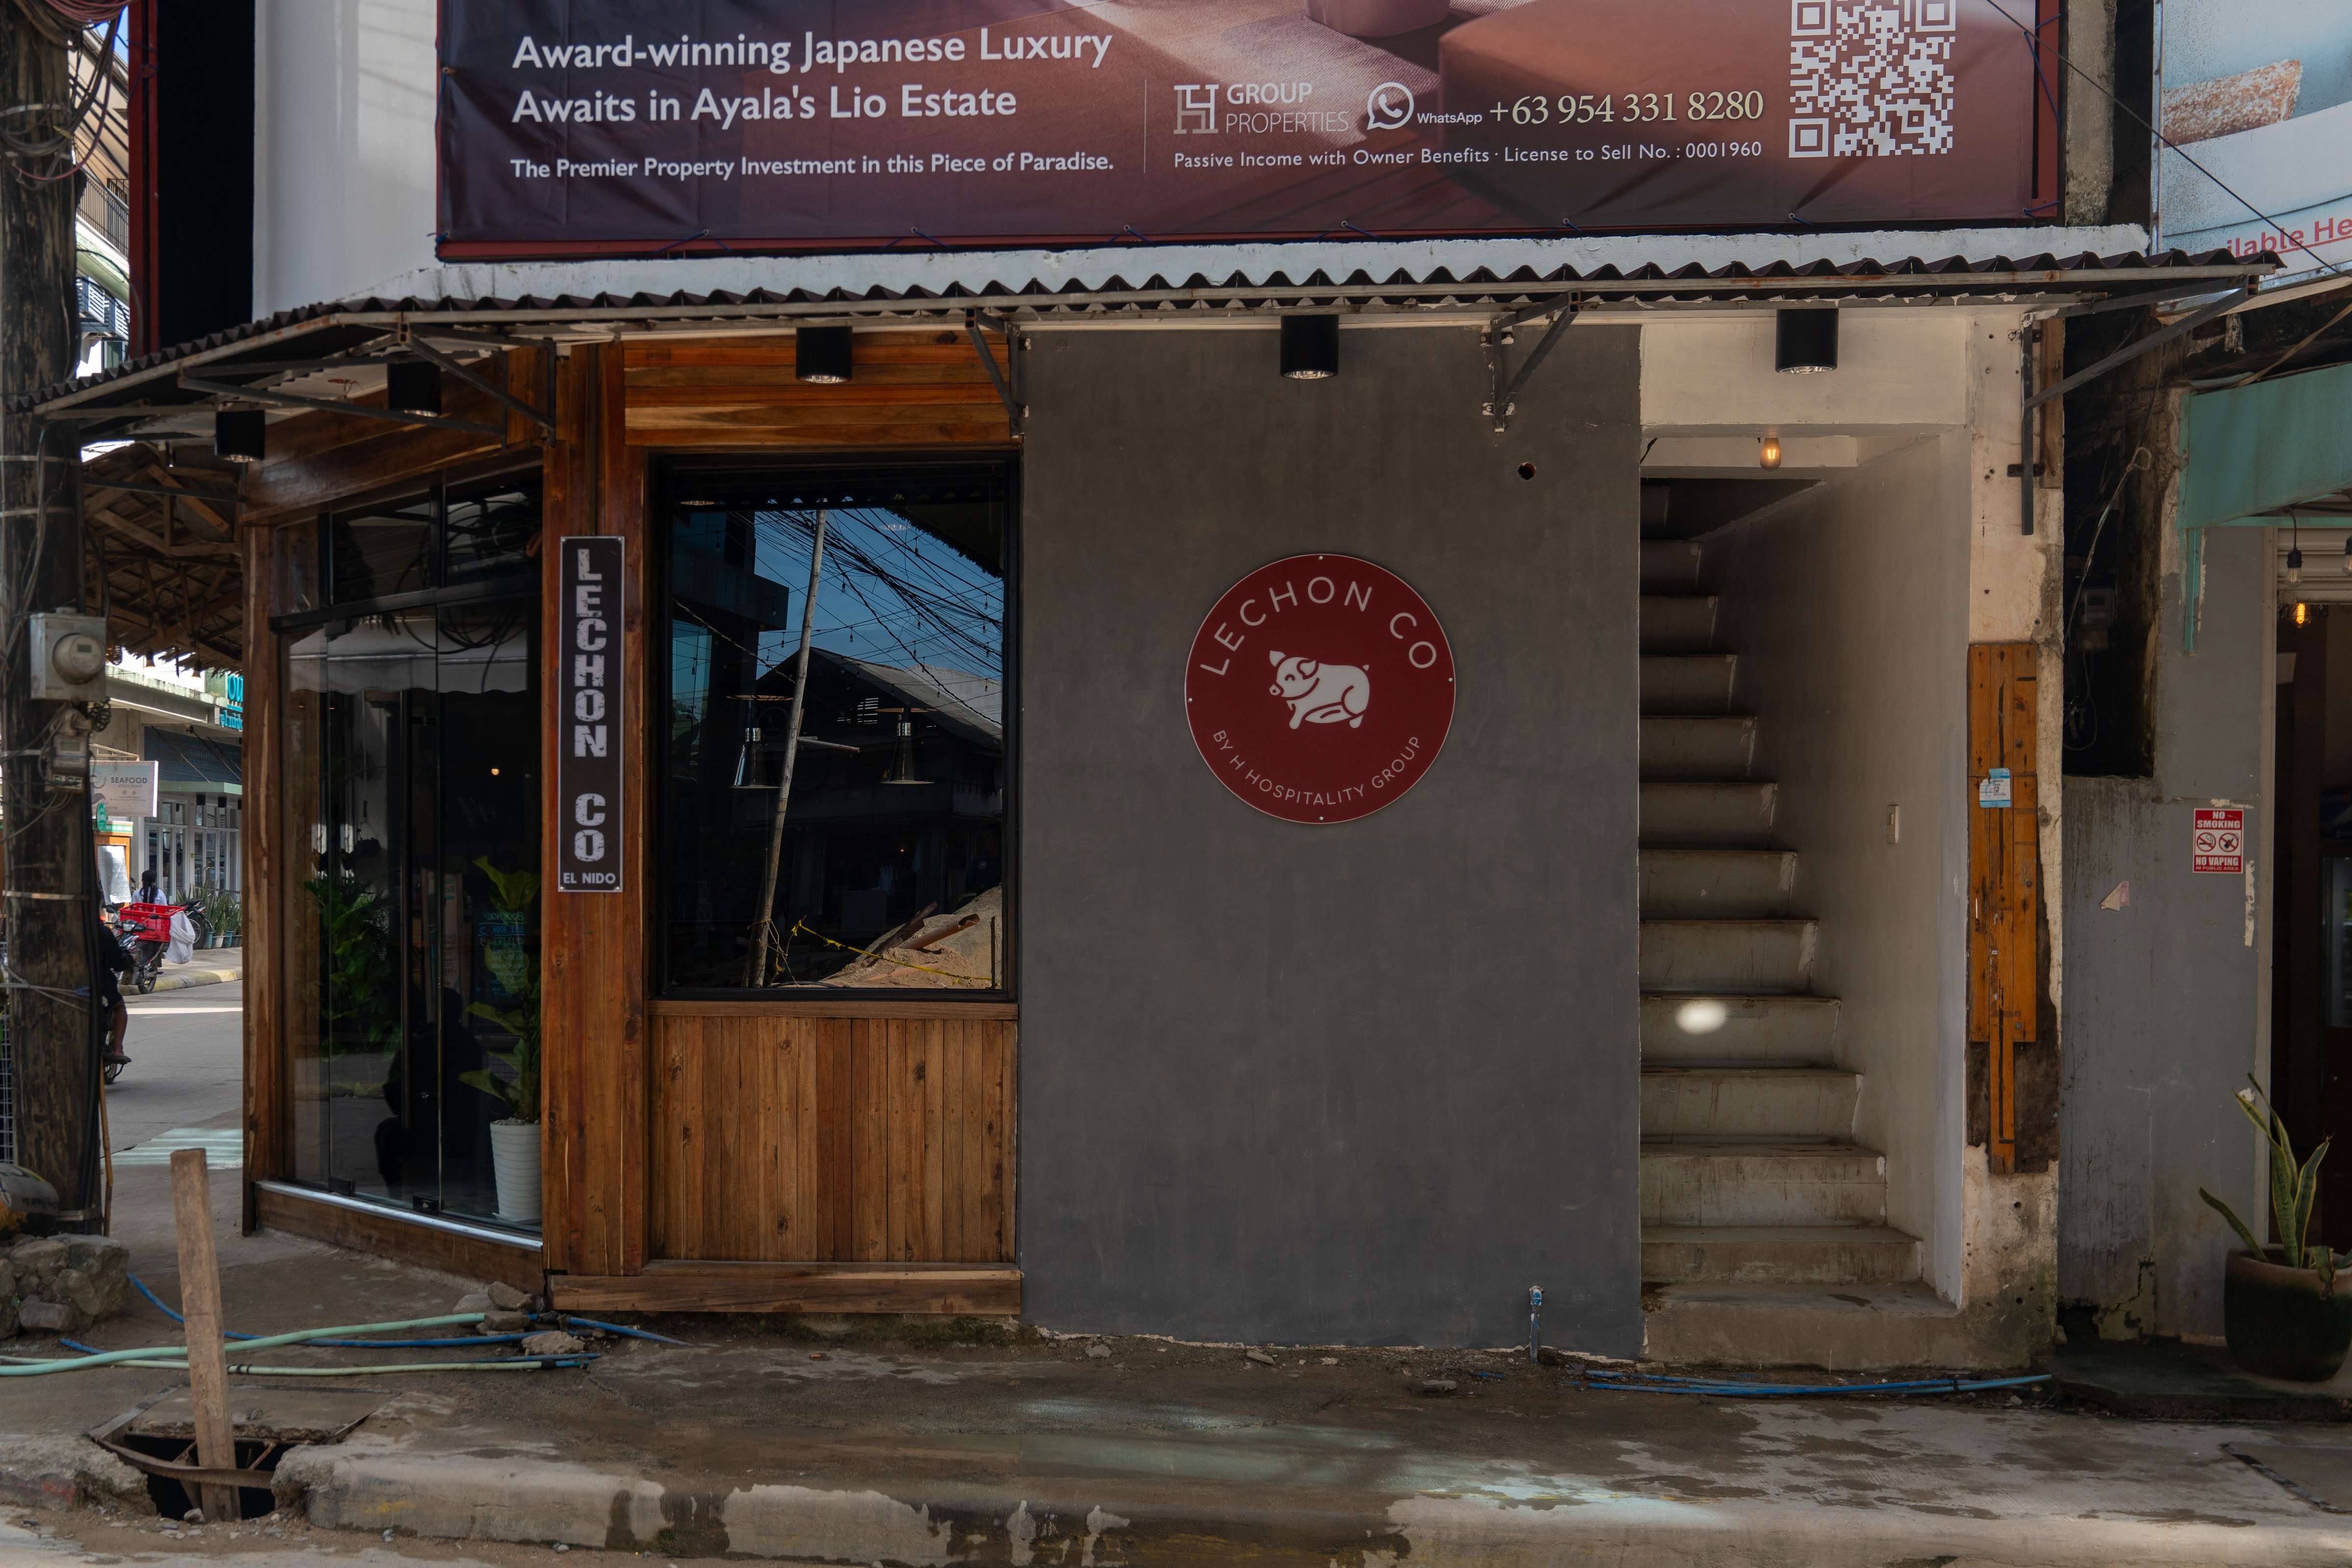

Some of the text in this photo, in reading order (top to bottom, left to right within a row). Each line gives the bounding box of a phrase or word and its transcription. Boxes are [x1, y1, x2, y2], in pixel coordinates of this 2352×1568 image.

[512, 28, 1113, 75] Award-winning Japanese Luxury
[1226, 82, 1314, 105] GROUP
[512, 84, 1017, 130] Awaits in Ayala's Lio Estate
[1416, 112, 1483, 126] WhatsApp
[1489, 90, 1764, 124] +63 954 331 8280
[1225, 111, 1350, 134] PROPERTIES
[509, 151, 1114, 182] The Premier Property Investment in this Piece of Paradise.
[1175, 152, 1234, 168] Passive
[1241, 151, 1302, 167] Income
[1309, 150, 1346, 166] with
[1353, 149, 1415, 165] Owner
[1421, 147, 1490, 164] Benefits
[1504, 146, 1568, 162] License
[1574, 148, 1594, 161] to
[1601, 144, 1631, 160] Sell
[1639, 144, 1670, 159] No.
[1685, 142, 1762, 158] 0001960
[1200, 576, 1437, 675] LECHON CO
[574, 549, 608, 862] LECHON CO
[1213, 730, 1421, 805] BY H HOSPITALITY GROUP
[2197, 820, 2241, 829] SMOKING
[2212, 811, 2226, 820] NO
[2196, 856, 2239, 866] NO VAPING
[563, 872, 616, 884] EL NIDO
